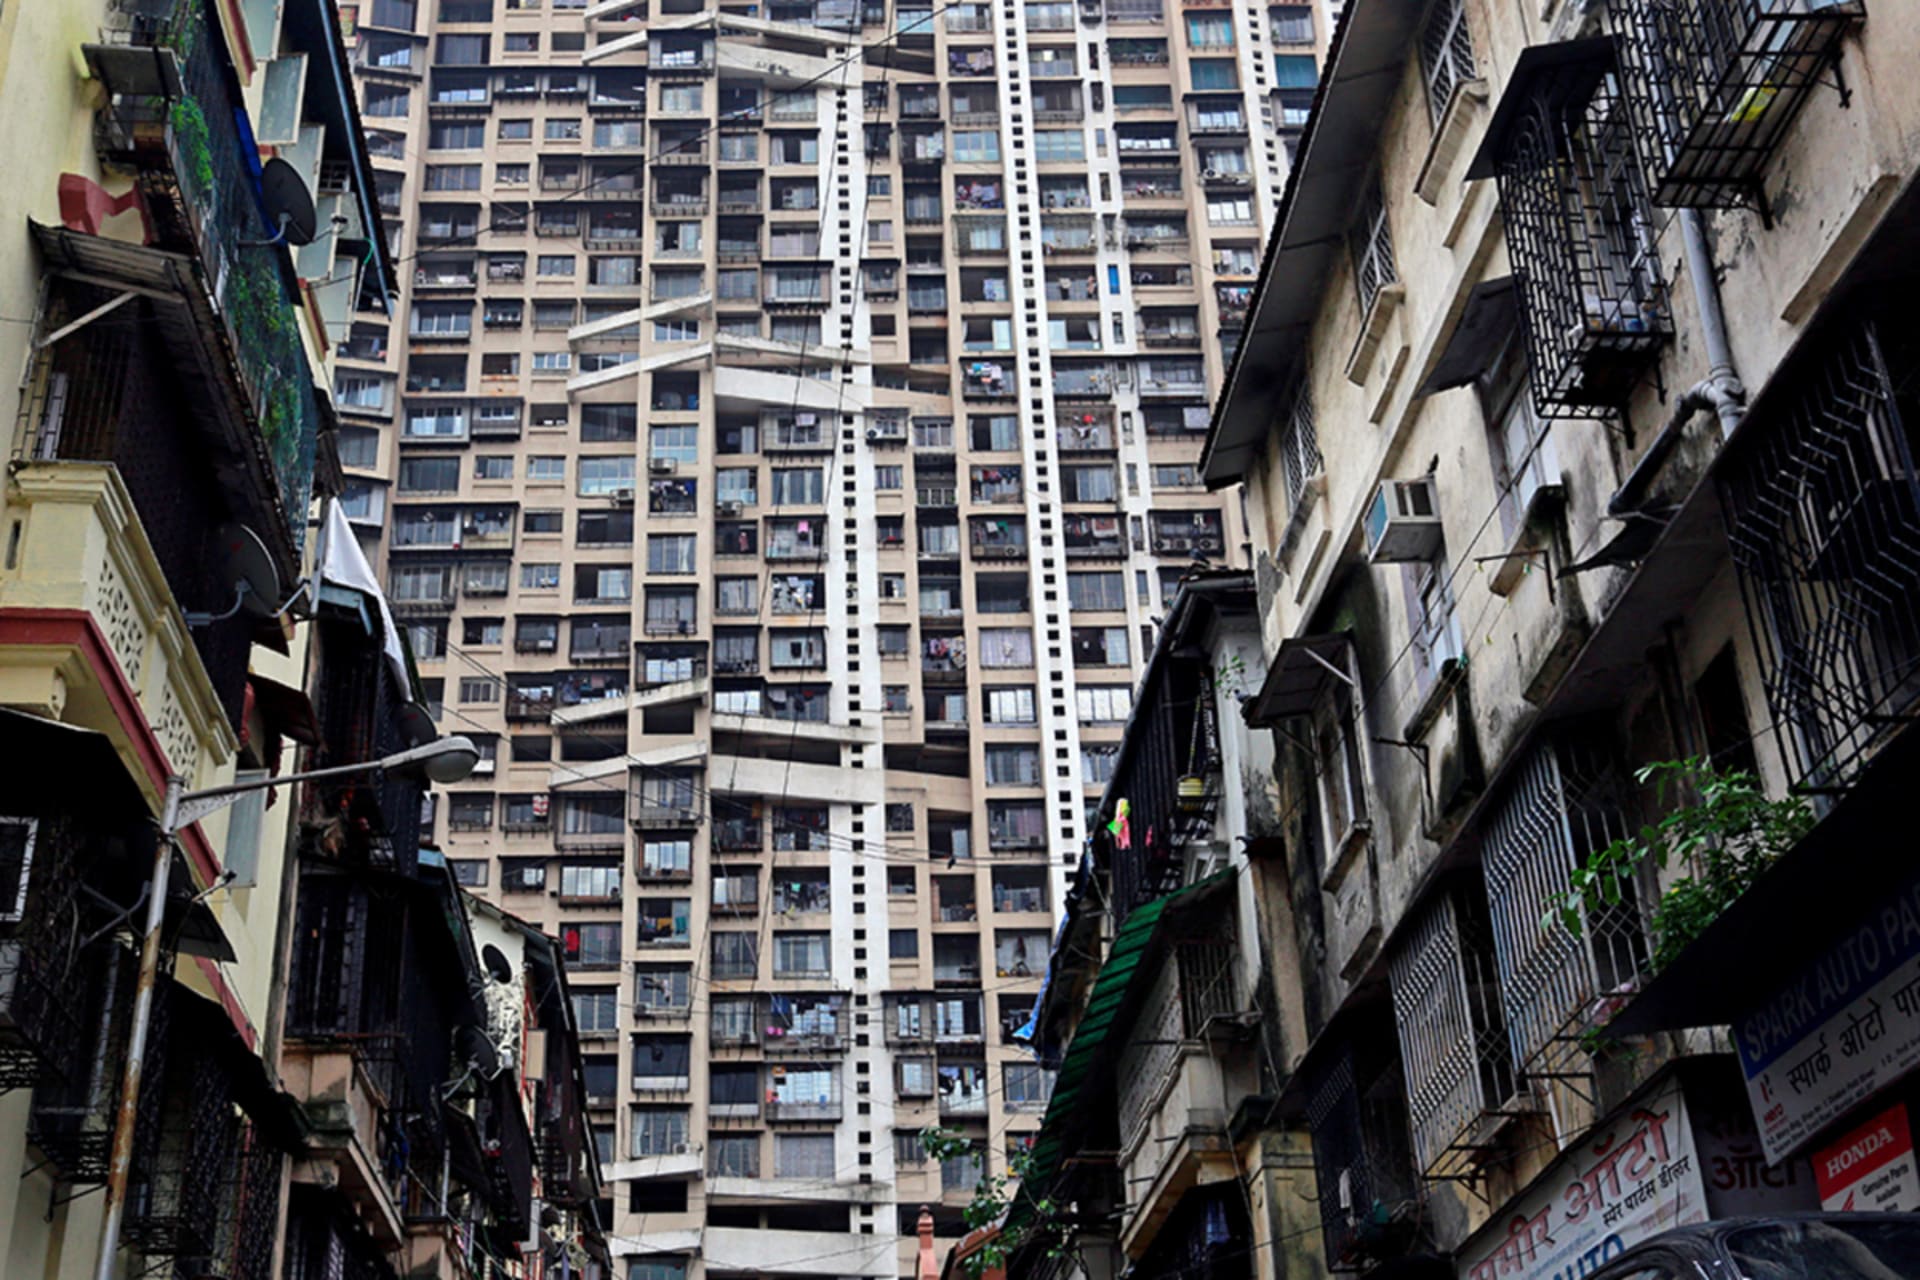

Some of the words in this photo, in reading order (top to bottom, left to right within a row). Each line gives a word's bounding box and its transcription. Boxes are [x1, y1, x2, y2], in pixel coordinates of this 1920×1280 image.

[1744, 974, 1818, 1063] SPARK
[1815, 924, 1881, 1009] AUTO
[1786, 1031, 1832, 1095] स्पार्क
[1838, 996, 1886, 1057] ओटो
[1564, 1108, 1670, 1224] ऑटो
[1826, 1127, 1895, 1180] HONDA
[1553, 1233, 1625, 1280] UTO
